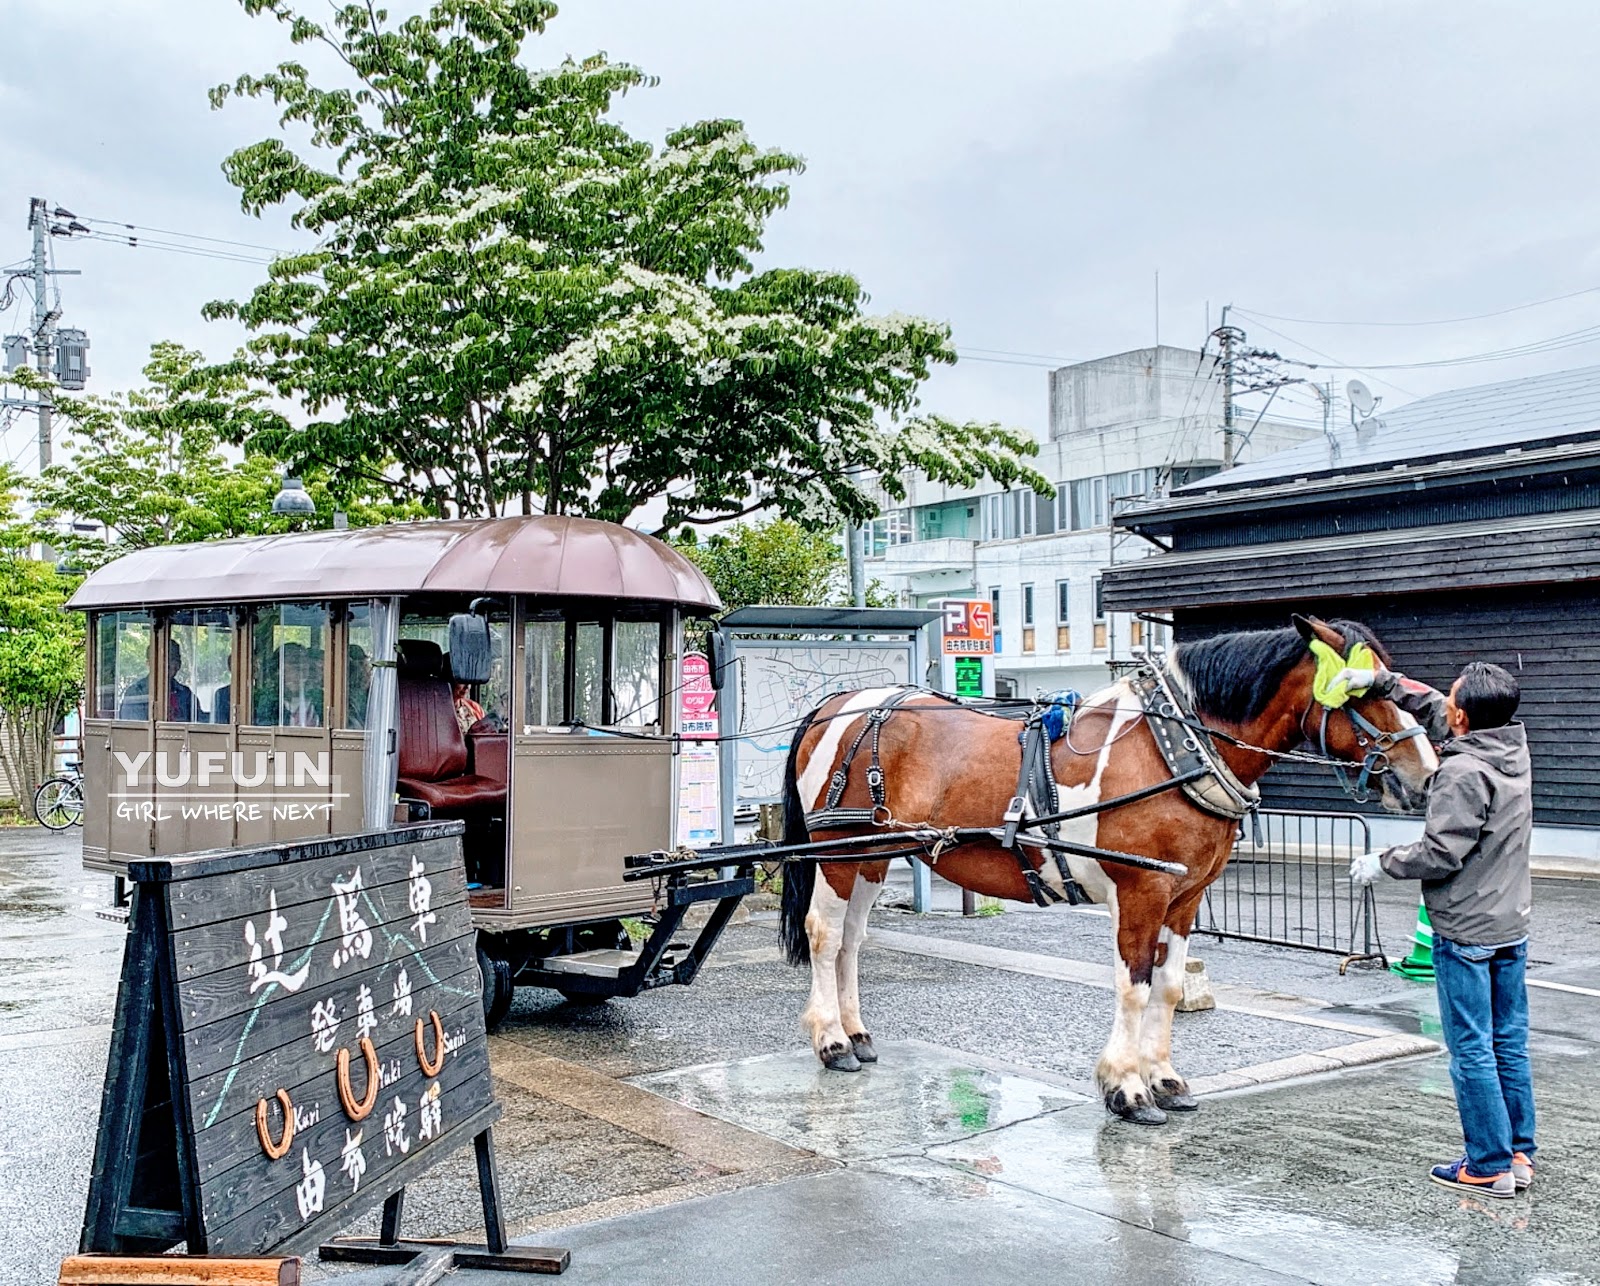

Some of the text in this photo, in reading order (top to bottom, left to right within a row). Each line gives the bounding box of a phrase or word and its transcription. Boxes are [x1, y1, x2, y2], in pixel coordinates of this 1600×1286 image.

[946, 605, 966, 632] P
[685, 696, 705, 705] のりば
[245, 855, 436, 994] 辻馬車
[377, 1060, 401, 1089] Yuki
